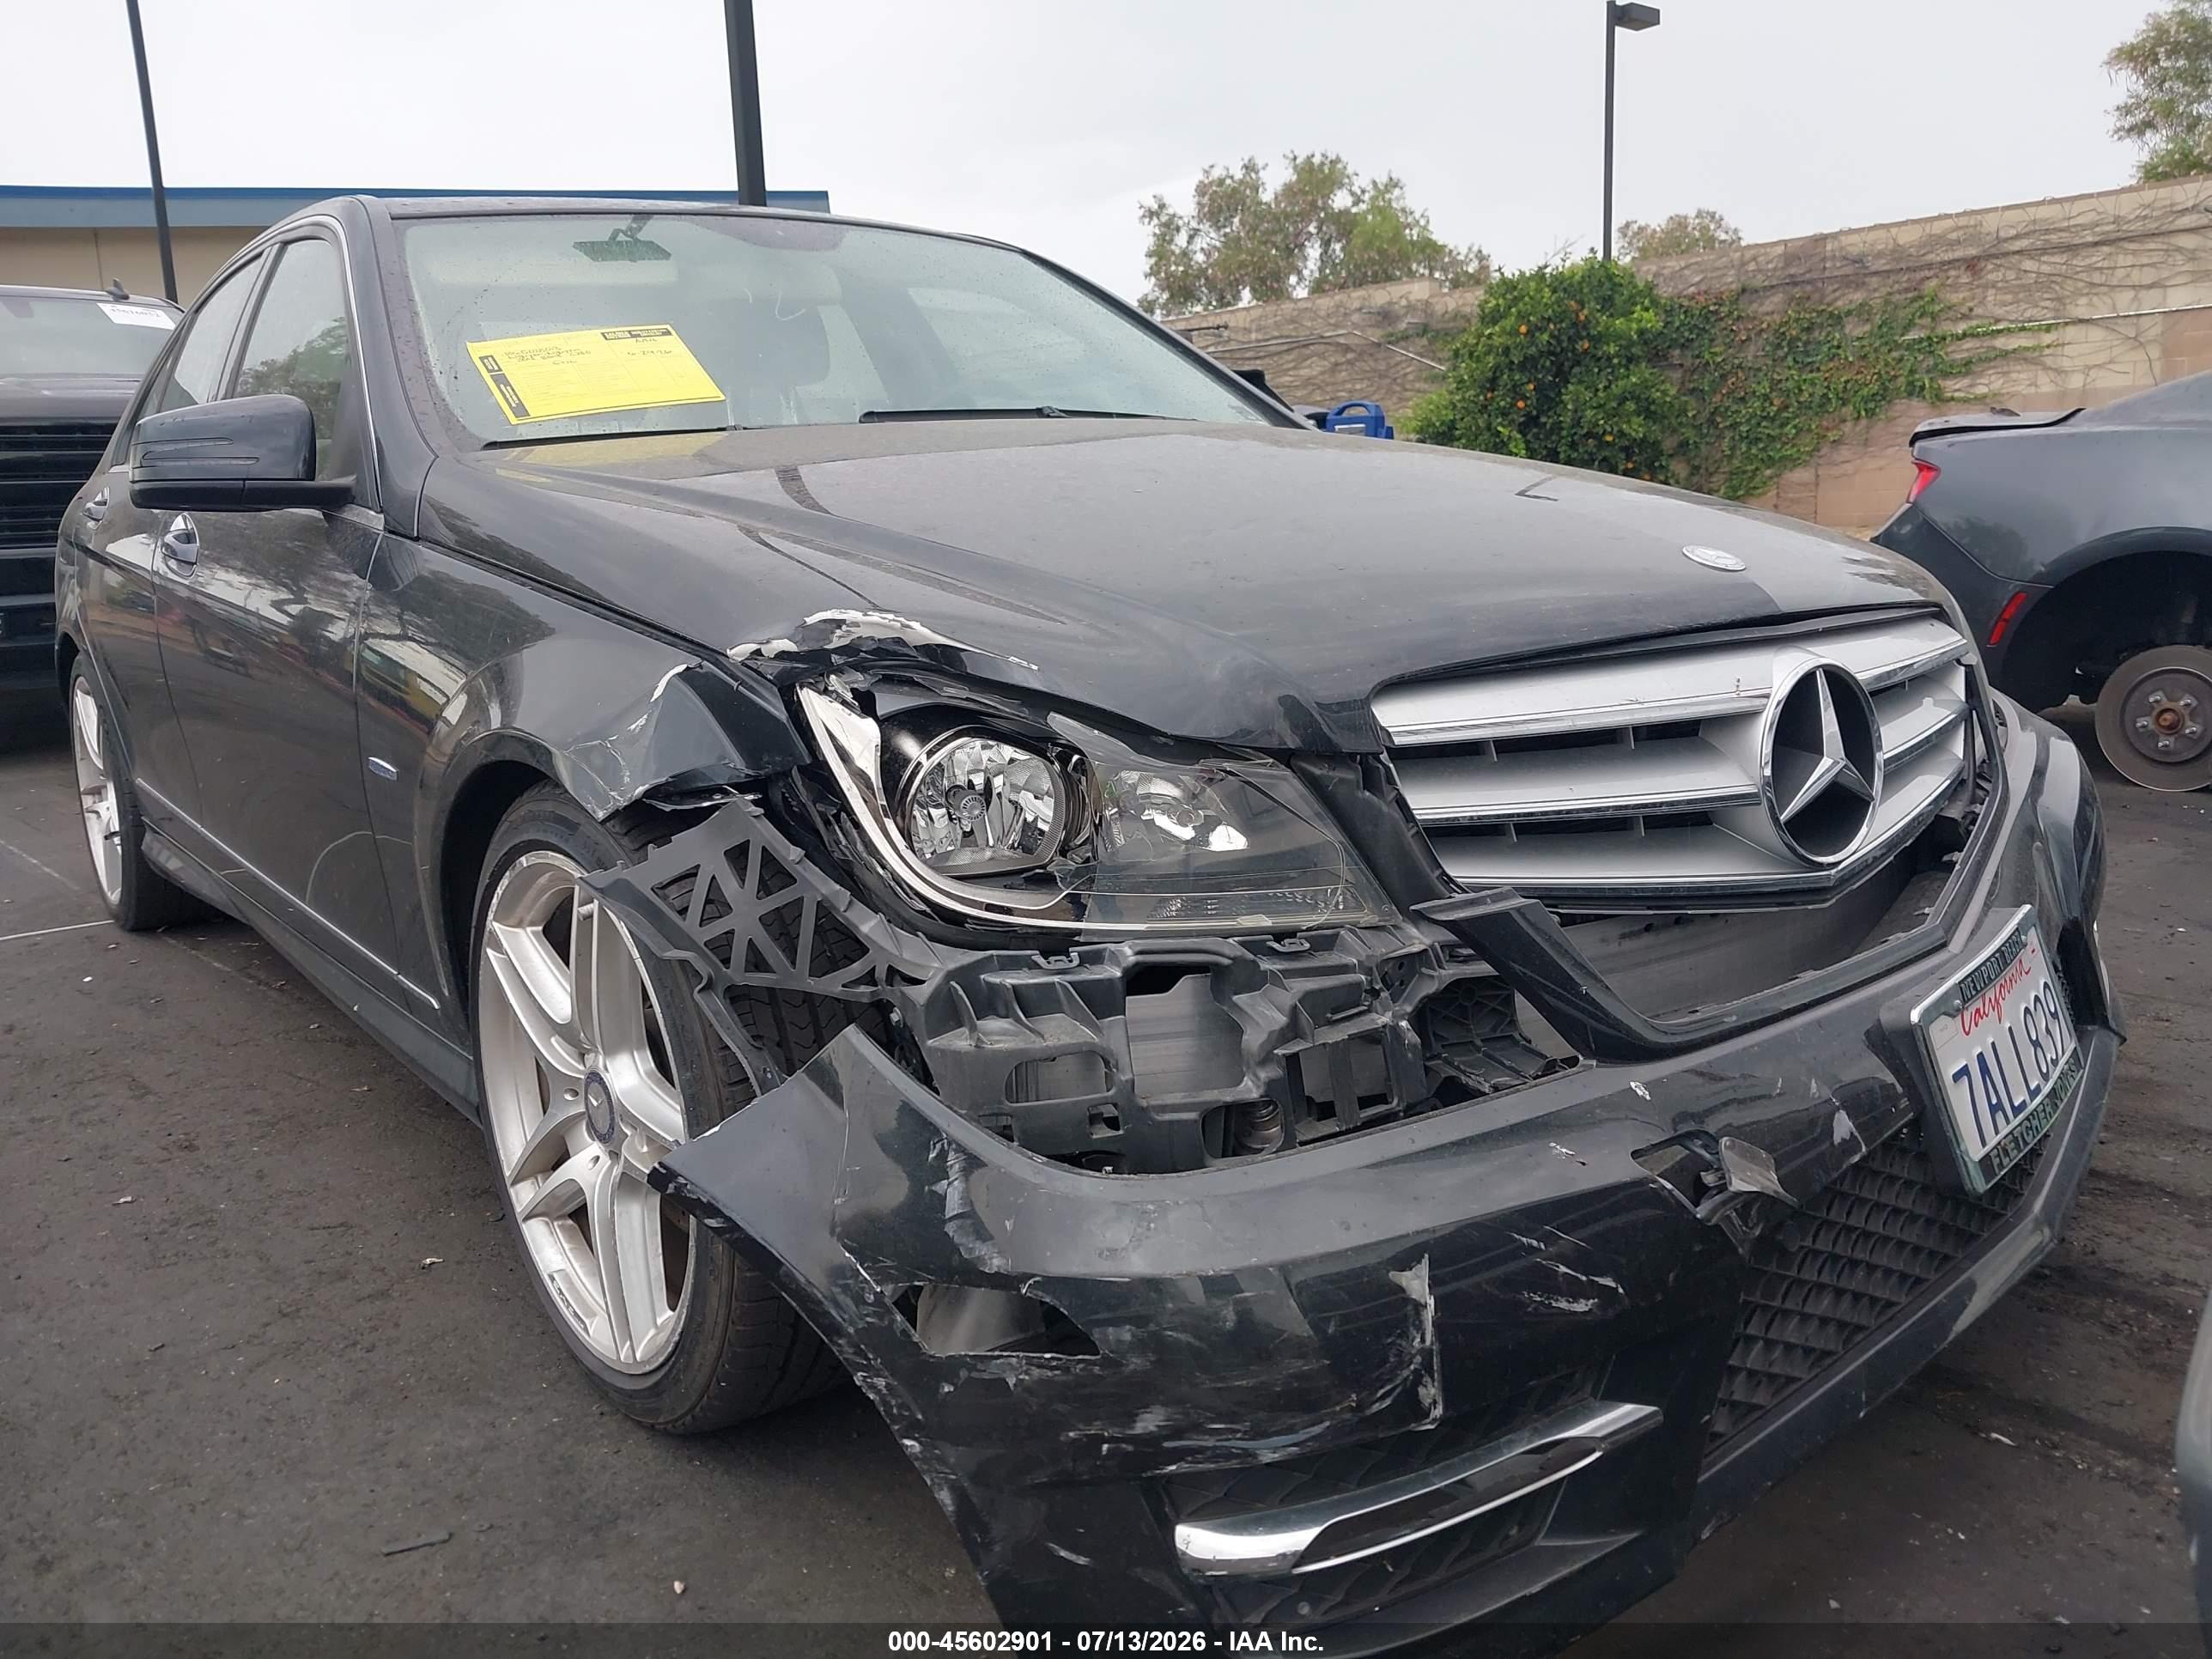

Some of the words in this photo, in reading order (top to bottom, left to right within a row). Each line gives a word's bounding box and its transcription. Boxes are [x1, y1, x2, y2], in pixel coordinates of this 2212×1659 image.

[1960, 951, 2004, 1003] NEWPORT
[2001, 930, 2022, 964] BEACH
[1960, 957, 2032, 1036] California
[1952, 981, 2064, 1148] 7ALL839
[1989, 1097, 2054, 1176] FLETCHER
[2053, 1057, 2078, 1108] JONES
